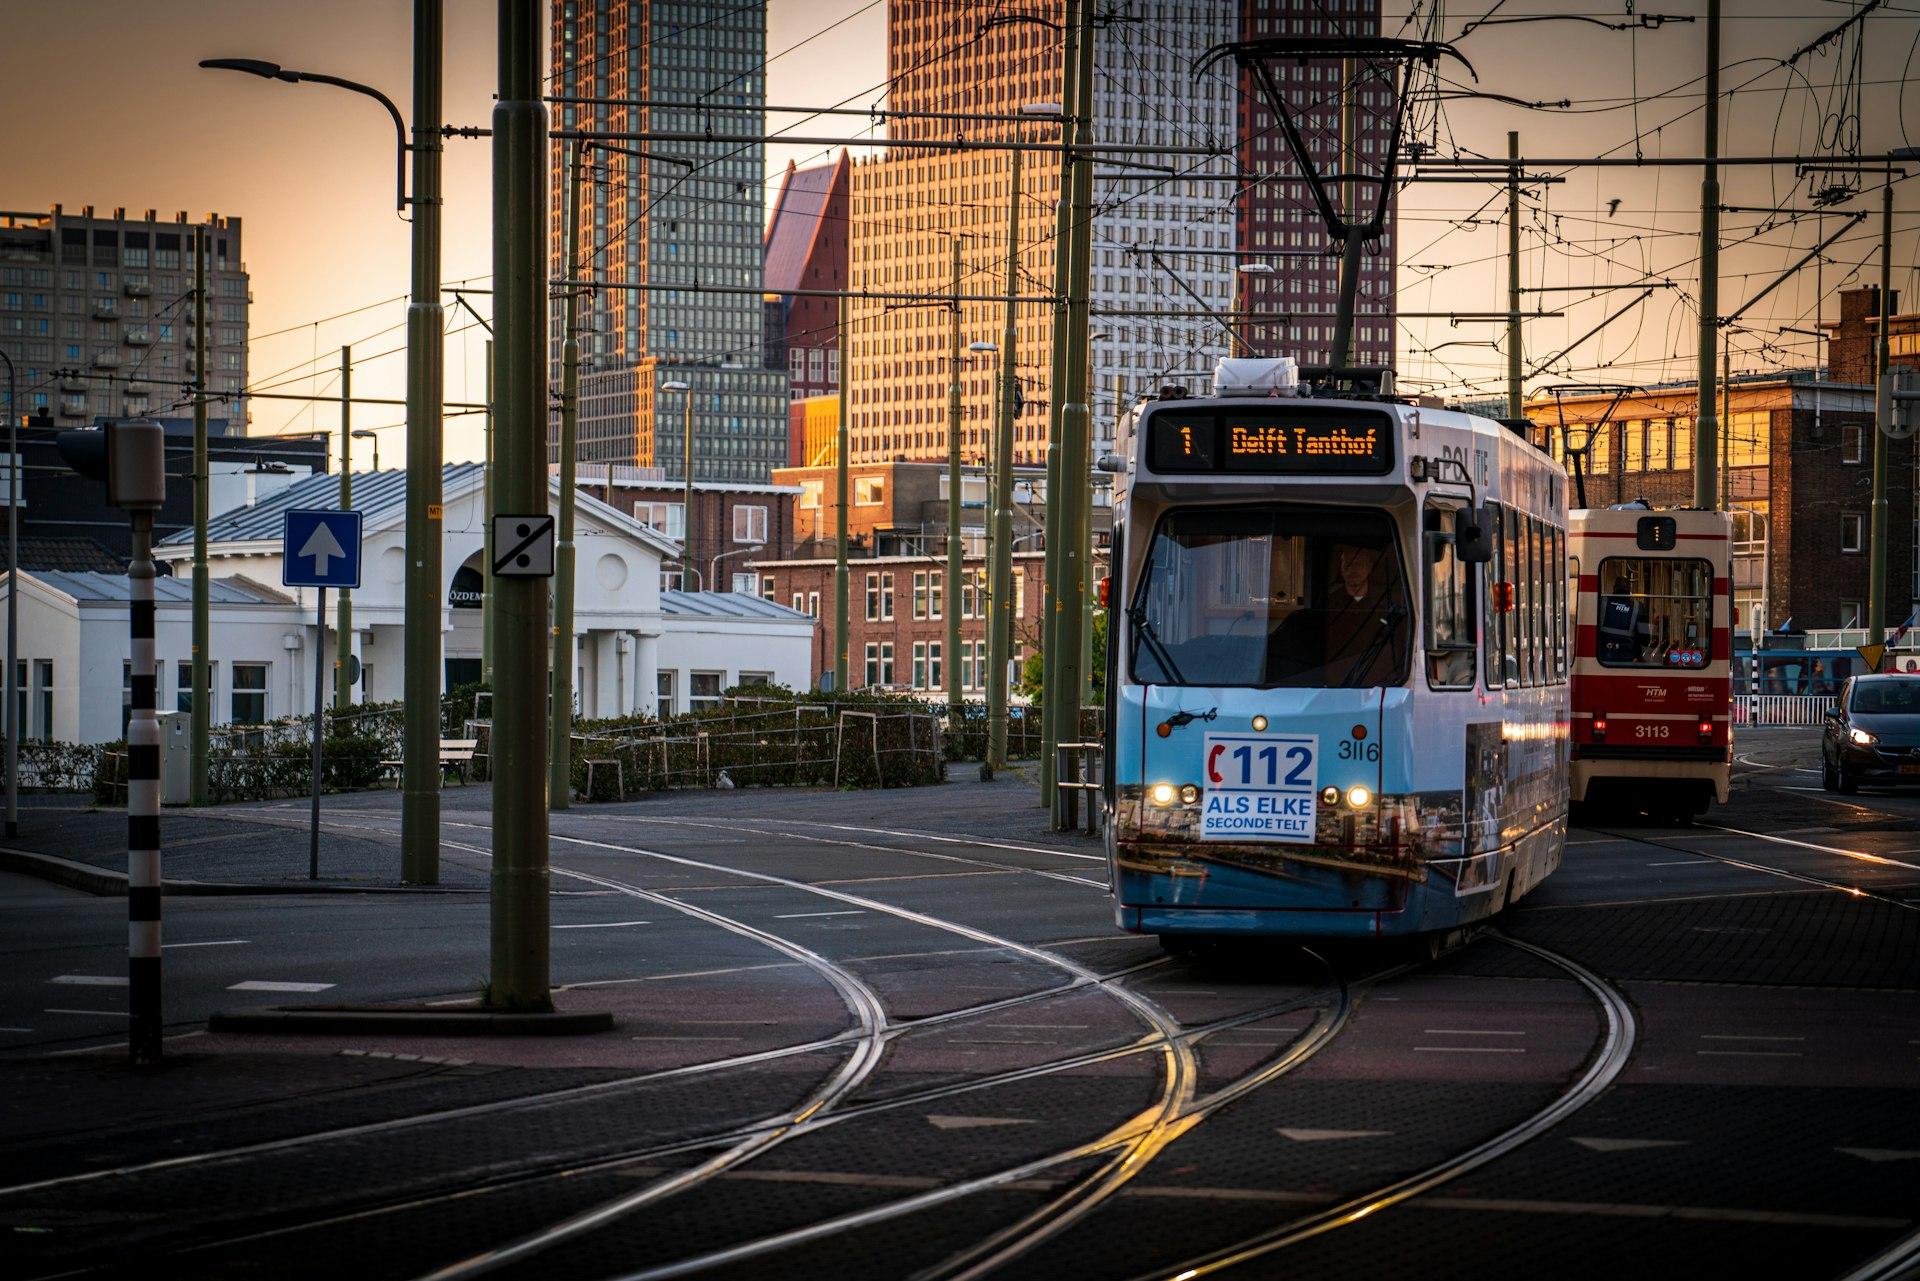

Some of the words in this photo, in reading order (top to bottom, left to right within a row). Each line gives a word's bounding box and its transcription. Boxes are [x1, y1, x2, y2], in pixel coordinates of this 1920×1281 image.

[1180, 427, 1191, 454] 1
[1232, 427, 1287, 454] Delft
[1294, 427, 1376, 455] Tanthof
[1646, 688, 1667, 697] HTM
[1635, 725, 1670, 739] 3113
[1338, 740, 1380, 762] 3116
[1233, 745, 1313, 786] 112
[1207, 796, 1250, 814] ALS
[1257, 798, 1311, 816] ELKE
[1206, 817, 1273, 829] SECONDE
[1275, 819, 1308, 831] TELT
